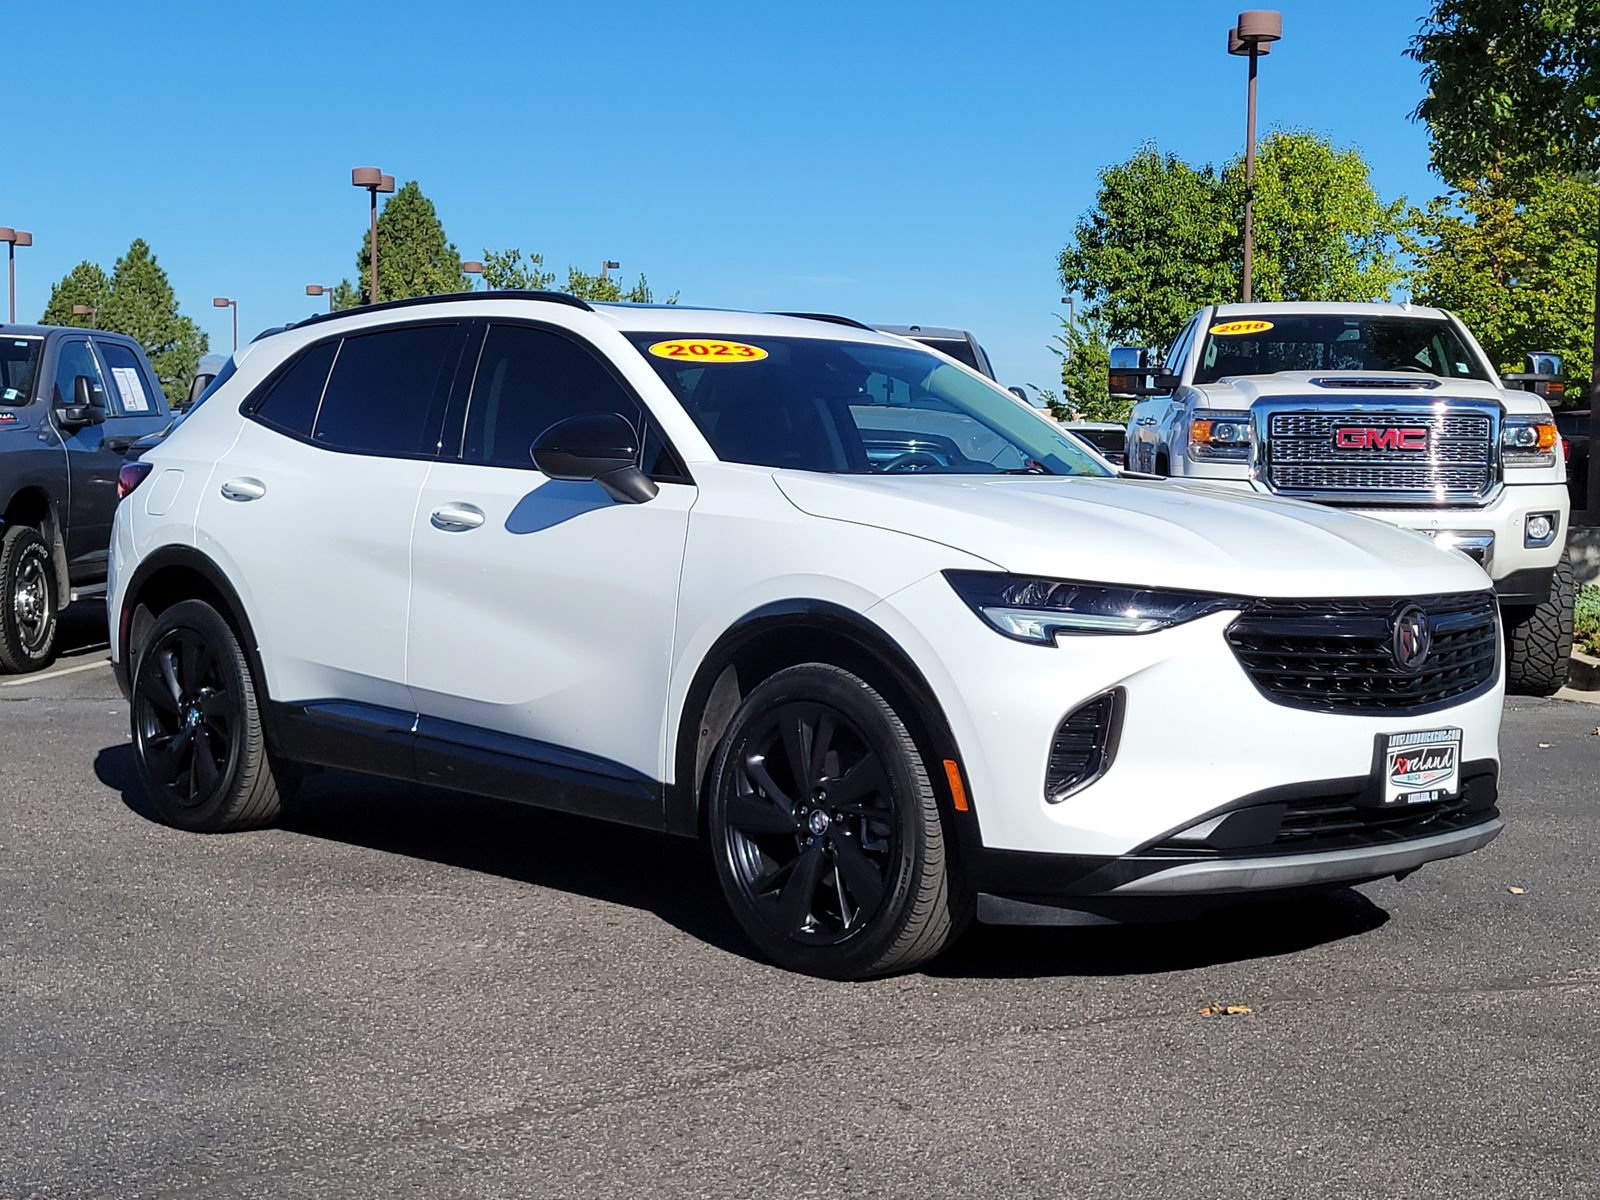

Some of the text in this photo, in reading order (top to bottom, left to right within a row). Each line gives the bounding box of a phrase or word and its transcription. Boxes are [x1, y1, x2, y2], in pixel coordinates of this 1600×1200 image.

[1217, 322, 1265, 333] 2018
[665, 344, 755, 357] 2023
[1336, 428, 1428, 449] GMC
